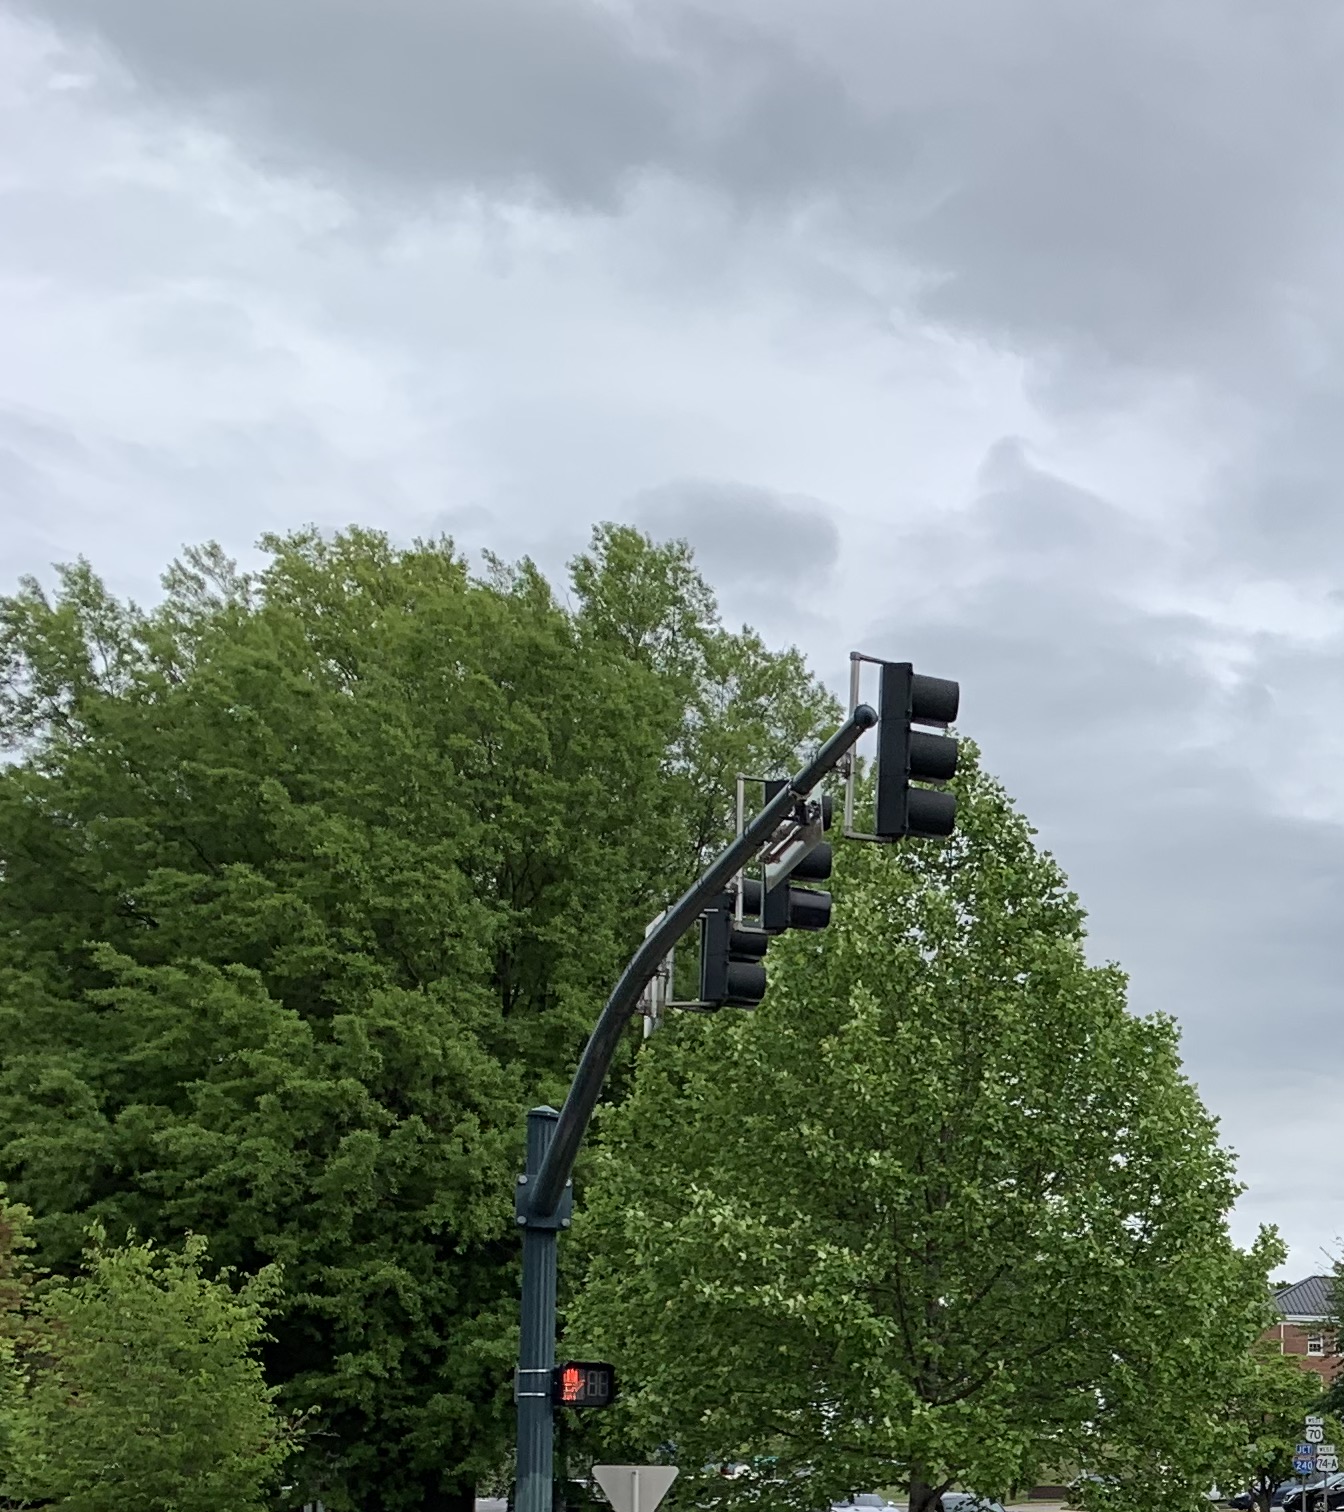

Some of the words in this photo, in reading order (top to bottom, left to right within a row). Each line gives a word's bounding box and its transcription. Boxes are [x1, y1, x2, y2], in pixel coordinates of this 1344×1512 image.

[1308, 1429, 1321, 1440] 70
[1296, 1445, 1311, 1454] JCT
[1296, 1461, 1313, 1470] 240
[1317, 1459, 1337, 1469] 74-A
